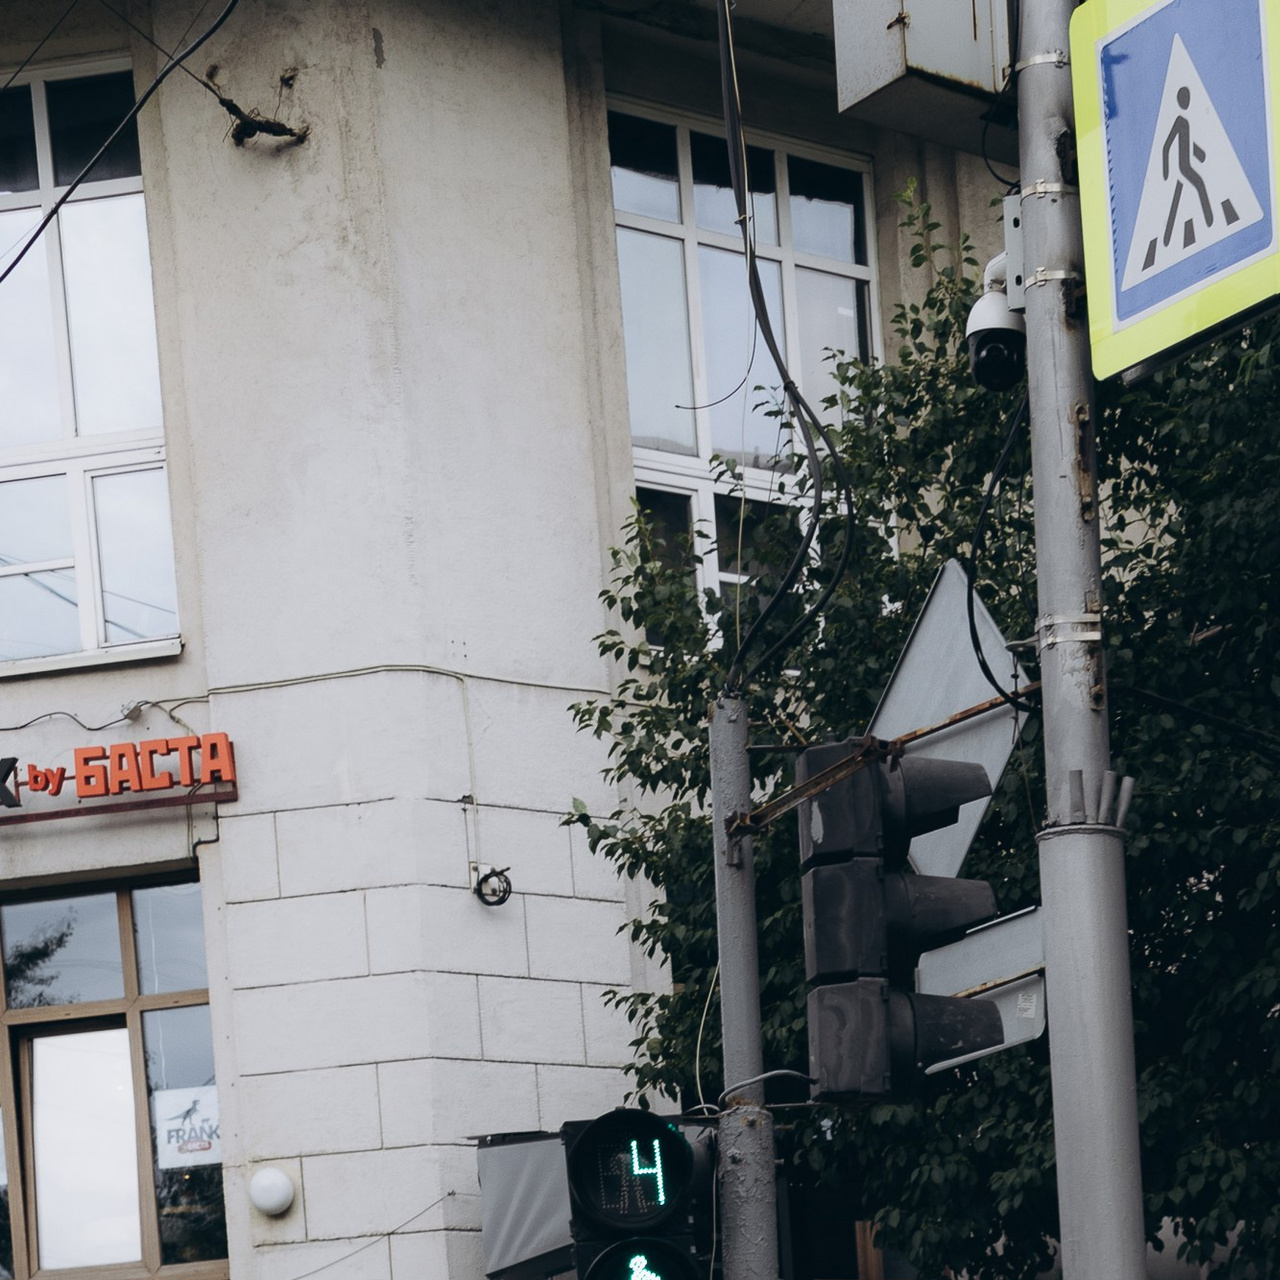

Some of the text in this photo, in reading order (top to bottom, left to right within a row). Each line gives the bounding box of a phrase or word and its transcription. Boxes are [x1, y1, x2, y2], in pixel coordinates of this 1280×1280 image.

[27, 764, 66, 796] by
[74, 732, 235, 798] БАСТА
[167, 1124, 220, 1144] FRANK
[630, 1139, 665, 1206] 4
